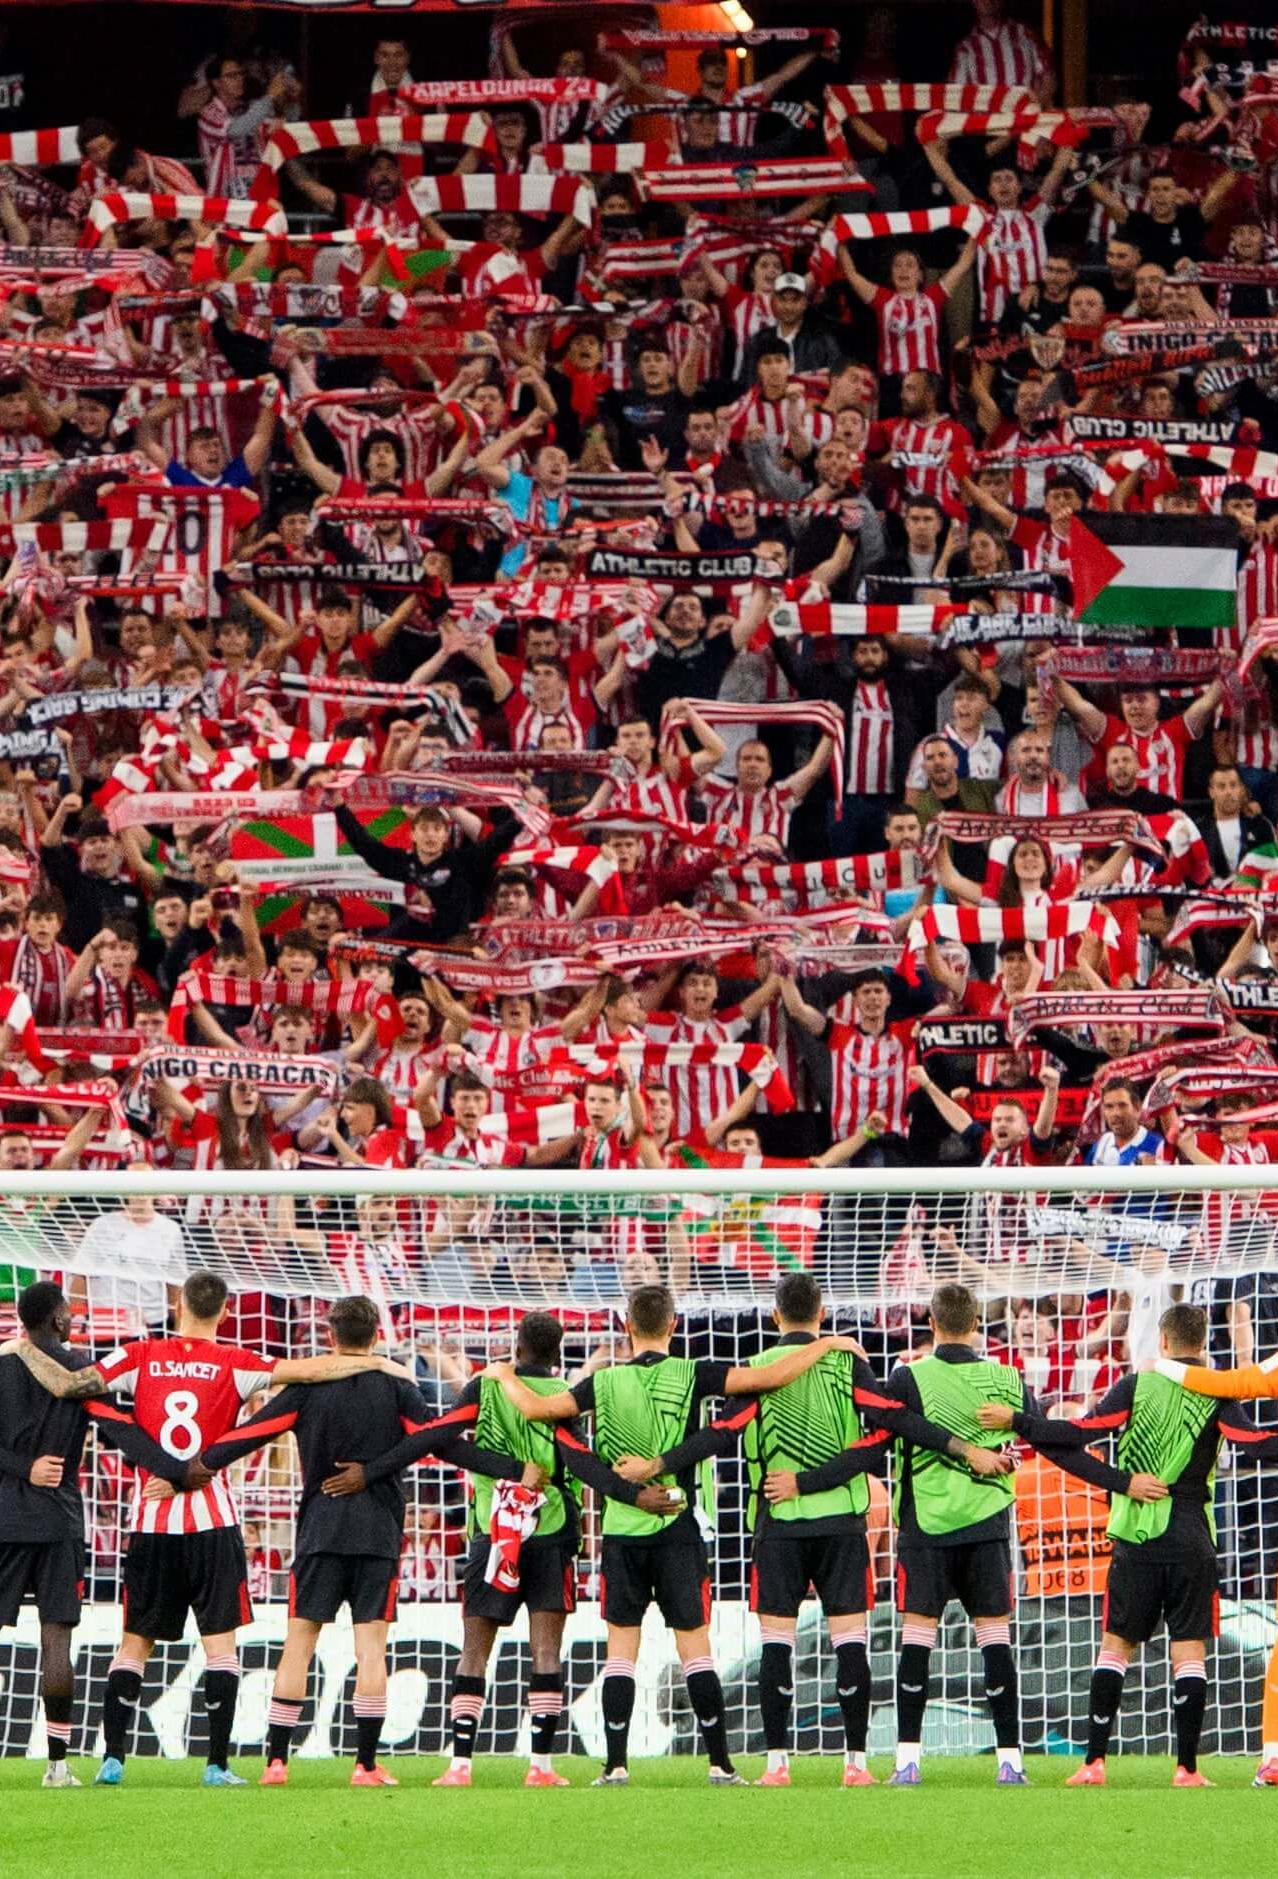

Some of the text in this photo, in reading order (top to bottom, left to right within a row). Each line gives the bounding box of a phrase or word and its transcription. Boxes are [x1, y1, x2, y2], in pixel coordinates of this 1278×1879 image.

[1072, 416, 1236, 443] ATHLETIC CLUB
[590, 551, 753, 579] ATHLETIC CLUB
[148, 1356, 221, 1381] O.SANCET
[159, 1390, 203, 1461] 8
